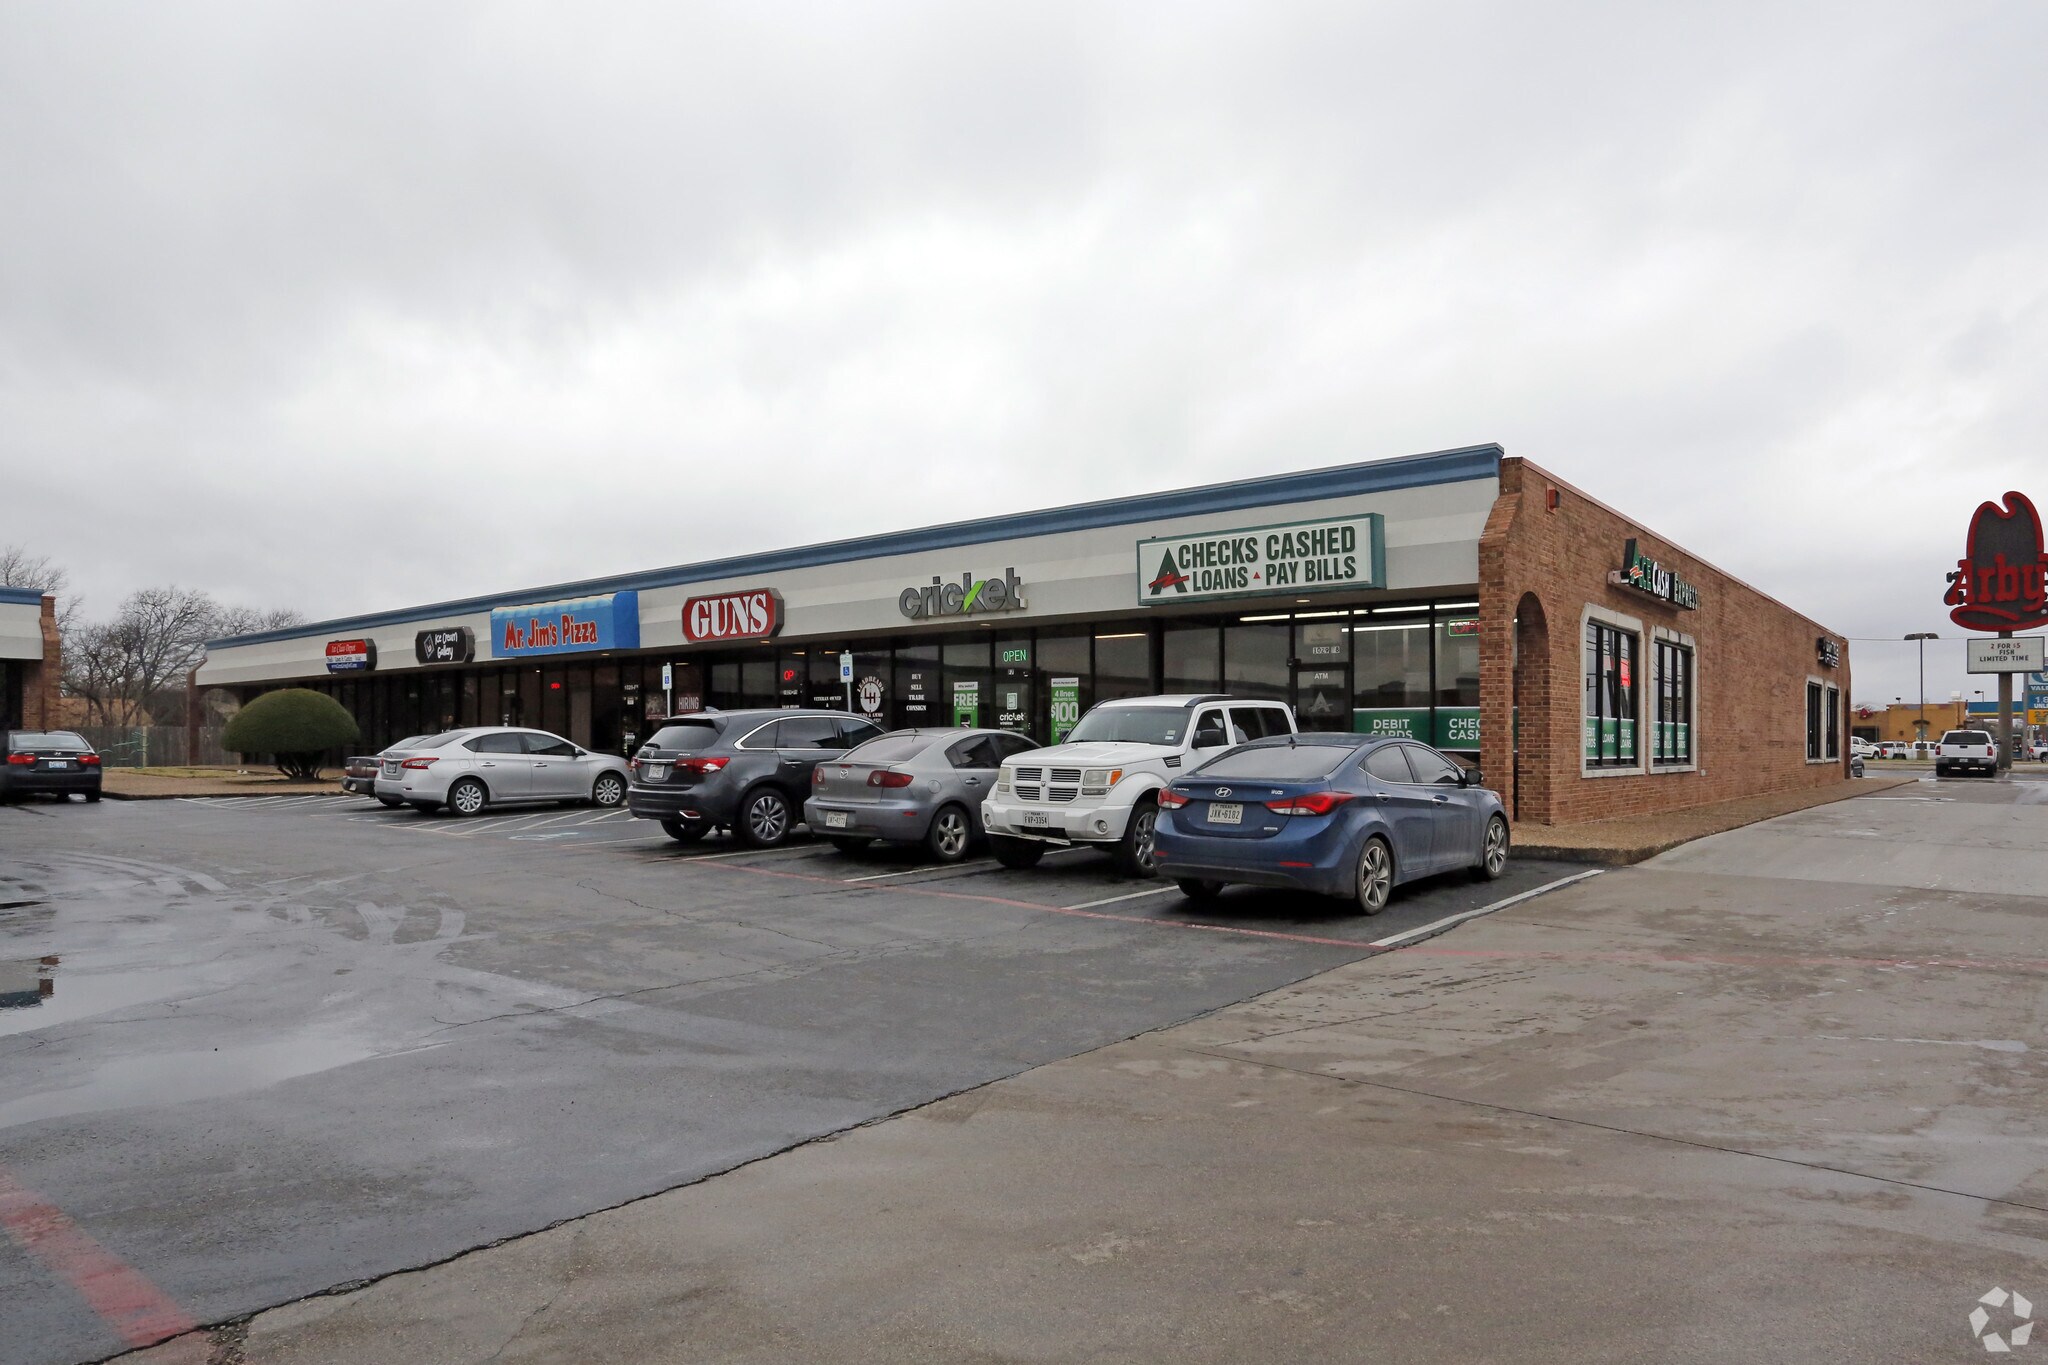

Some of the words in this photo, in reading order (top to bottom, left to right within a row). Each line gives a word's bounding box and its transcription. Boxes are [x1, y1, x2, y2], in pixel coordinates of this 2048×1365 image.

[1178, 537, 1258, 570] CHECKS
[1266, 525, 1356, 561] CASHED
[1193, 566, 1248, 592] LOANS
[1265, 561, 1299, 586] PAY
[1304, 555, 1357, 582] BILLS
[899, 567, 1021, 619] cricket
[690, 593, 769, 638] GUNS
[504, 619, 525, 650] Mr.
[527, 617, 558, 648] Jim's
[561, 614, 598, 645] Pizza
[1003, 649, 1028, 662] OPEN
[1314, 672, 1328, 680] ATM
[954, 693, 978, 707] FREE
[1060, 689, 1075, 697] lines
[678, 696, 700, 710] HIRING
[999, 712, 1025, 721] cricket
[1051, 702, 1079, 722] $100
[1373, 719, 1410, 729] DEBIT
[1586, 727, 1595, 737] EBIT
